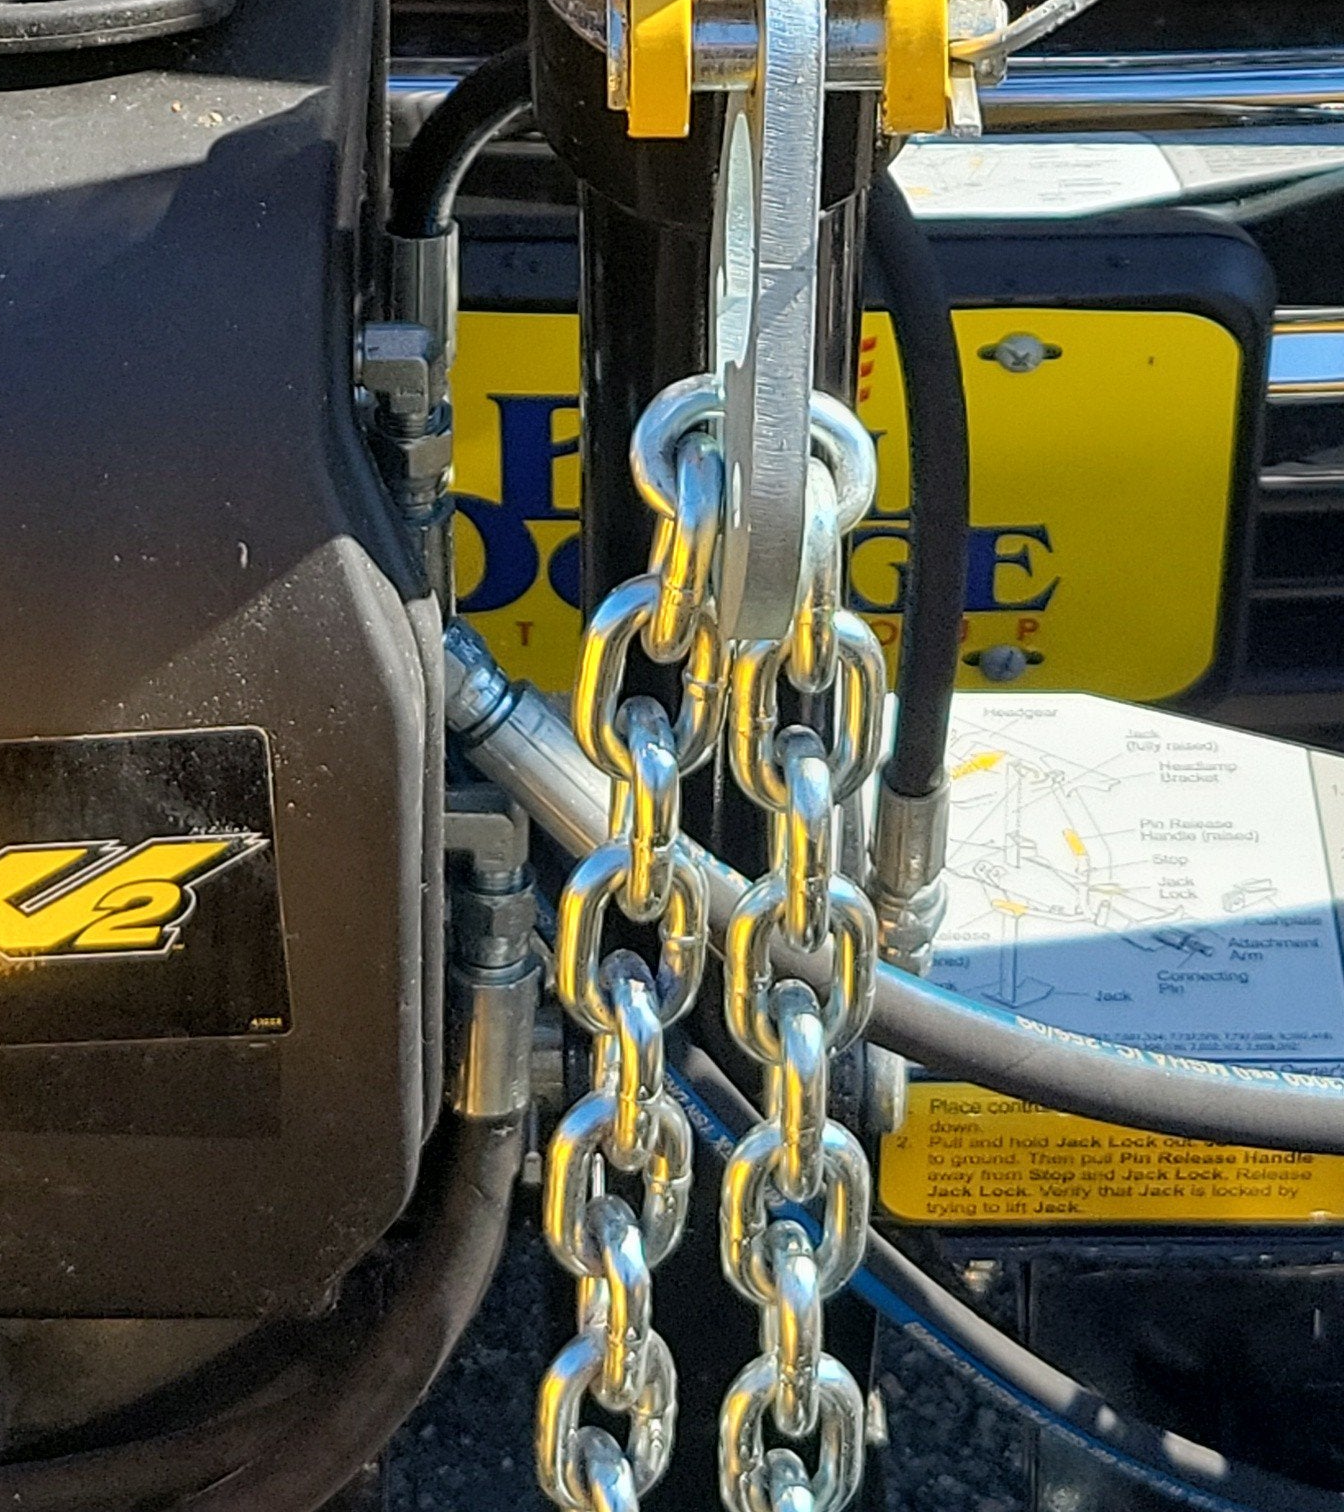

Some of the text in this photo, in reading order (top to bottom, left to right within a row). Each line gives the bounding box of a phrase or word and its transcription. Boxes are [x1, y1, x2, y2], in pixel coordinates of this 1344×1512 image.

[1169, 818, 1234, 829] Release
[1140, 830, 1198, 841] Handle
[1159, 888, 1198, 900] Lock
[1228, 937, 1320, 948] Attachment
[1230, 949, 1264, 961] Arm
[1157, 969, 1250, 984] Connecting
[1095, 990, 1134, 1002] Jack
[930, 1098, 982, 1114] Place
[929, 1135, 1158, 1148] Pull and hold Jack Lock
[951, 1152, 1019, 1168] ground.
[1029, 1152, 1075, 1165] Then
[1119, 1152, 1152, 1165] Pin
[1157, 1152, 1237, 1165] Release
[1243, 1152, 1315, 1165] Handle
[927, 1169, 976, 1184] away
[1029, 1169, 1076, 1184] Stop
[1121, 1169, 1169, 1181] Jack
[1174, 1169, 1230, 1181] Lock.
[1236, 1169, 1313, 1181] Release
[927, 1185, 972, 1198] Jack
[979, 1185, 1032, 1198] Lock.
[1098, 1185, 1133, 1198] that
[1138, 1185, 1185, 1198] Jack
[1212, 1185, 1272, 1198] locked
[1278, 1185, 1299, 1201] by
[926, 1201, 1087, 1216] trying to lift Jack.
